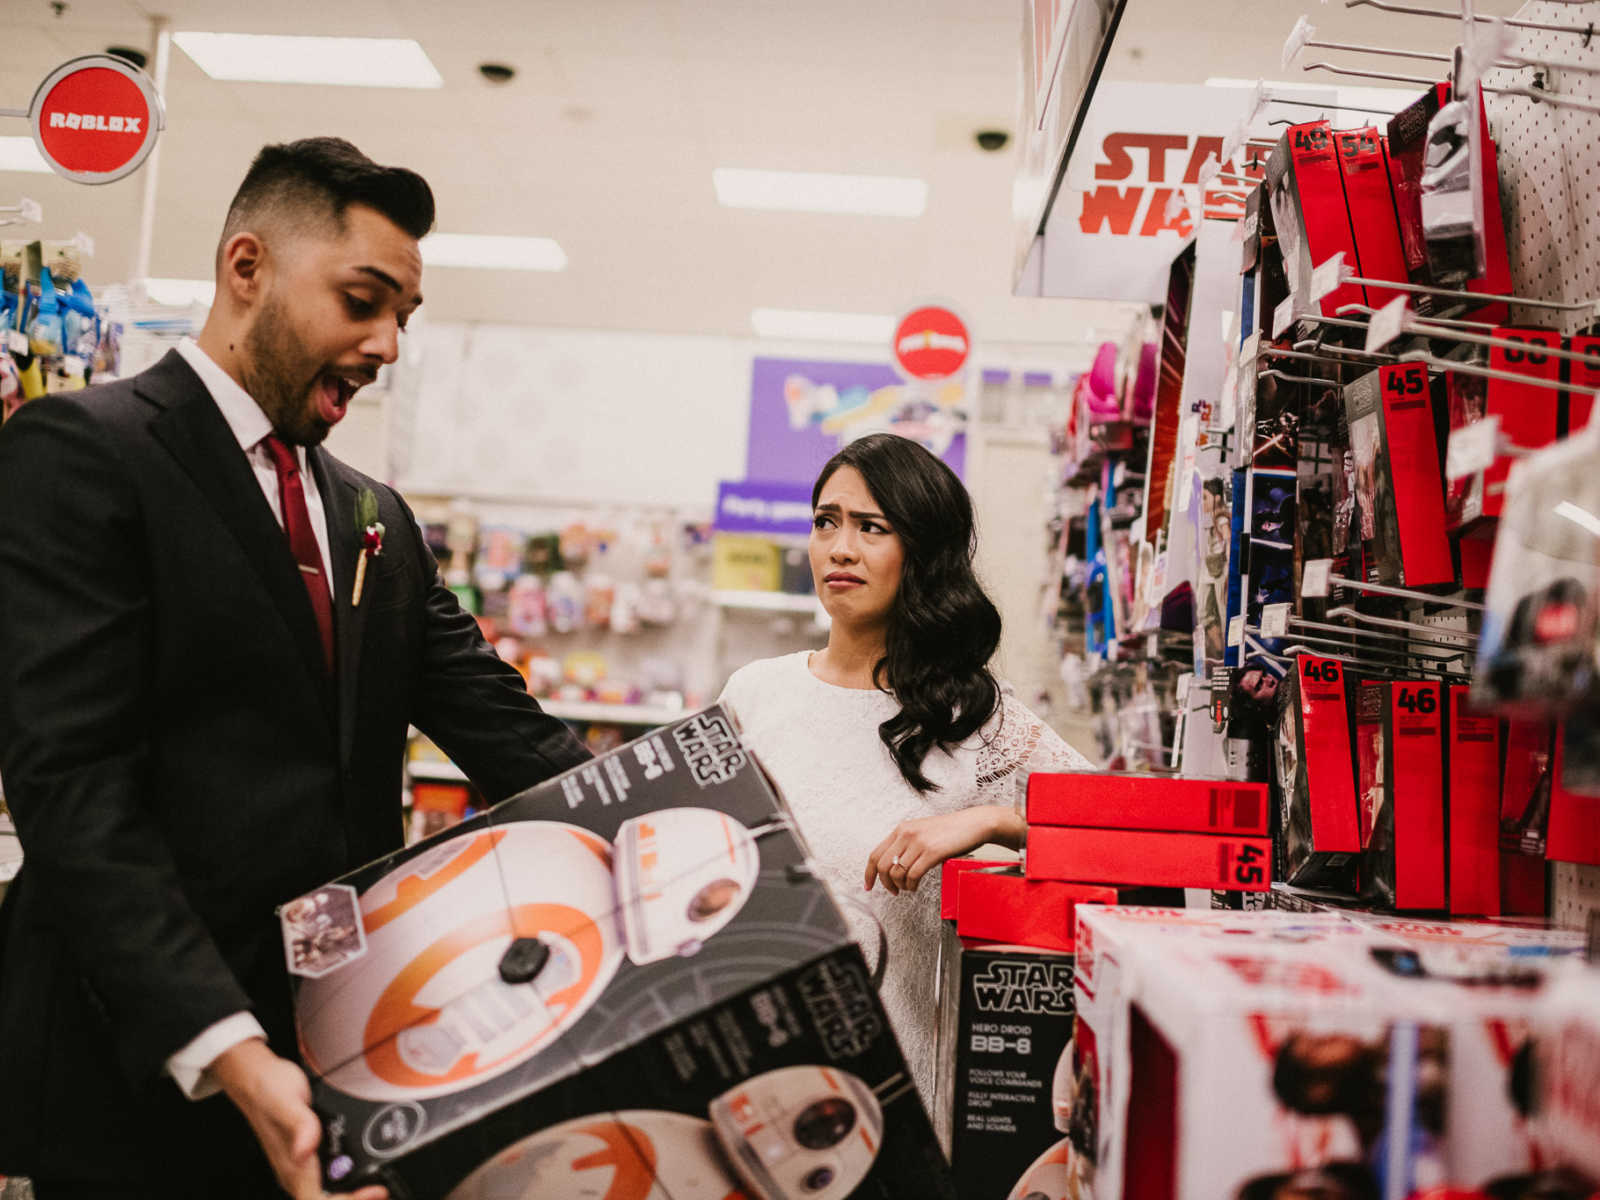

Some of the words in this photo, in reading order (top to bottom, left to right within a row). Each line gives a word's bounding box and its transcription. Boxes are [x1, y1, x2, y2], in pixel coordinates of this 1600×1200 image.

[50, 112, 141, 133] ROBLOX
[1295, 127, 1328, 151] 49
[1342, 132, 1377, 157] 54
[1387, 369, 1424, 395] 45
[1304, 660, 1339, 682] 46
[1398, 688, 1436, 713] 46
[672, 719, 716, 787] WARS
[697, 714, 746, 784] STAR
[1236, 844, 1264, 884] 45
[973, 961, 1075, 990] STAR
[973, 985, 1077, 1015] WARS
[972, 1023, 998, 1033] HERO
[1001, 1024, 1032, 1035] DROID
[971, 1035, 1031, 1054] BB-8
[969, 1069, 1004, 1078] FOLLOWS
[1006, 1071, 1027, 1079] YOUR
[969, 1077, 993, 1085] VOICE
[995, 1079, 1042, 1088] COMMANDS
[990, 1093, 1036, 1103] INTERACTIVE
[966, 1122, 984, 1130] AND
